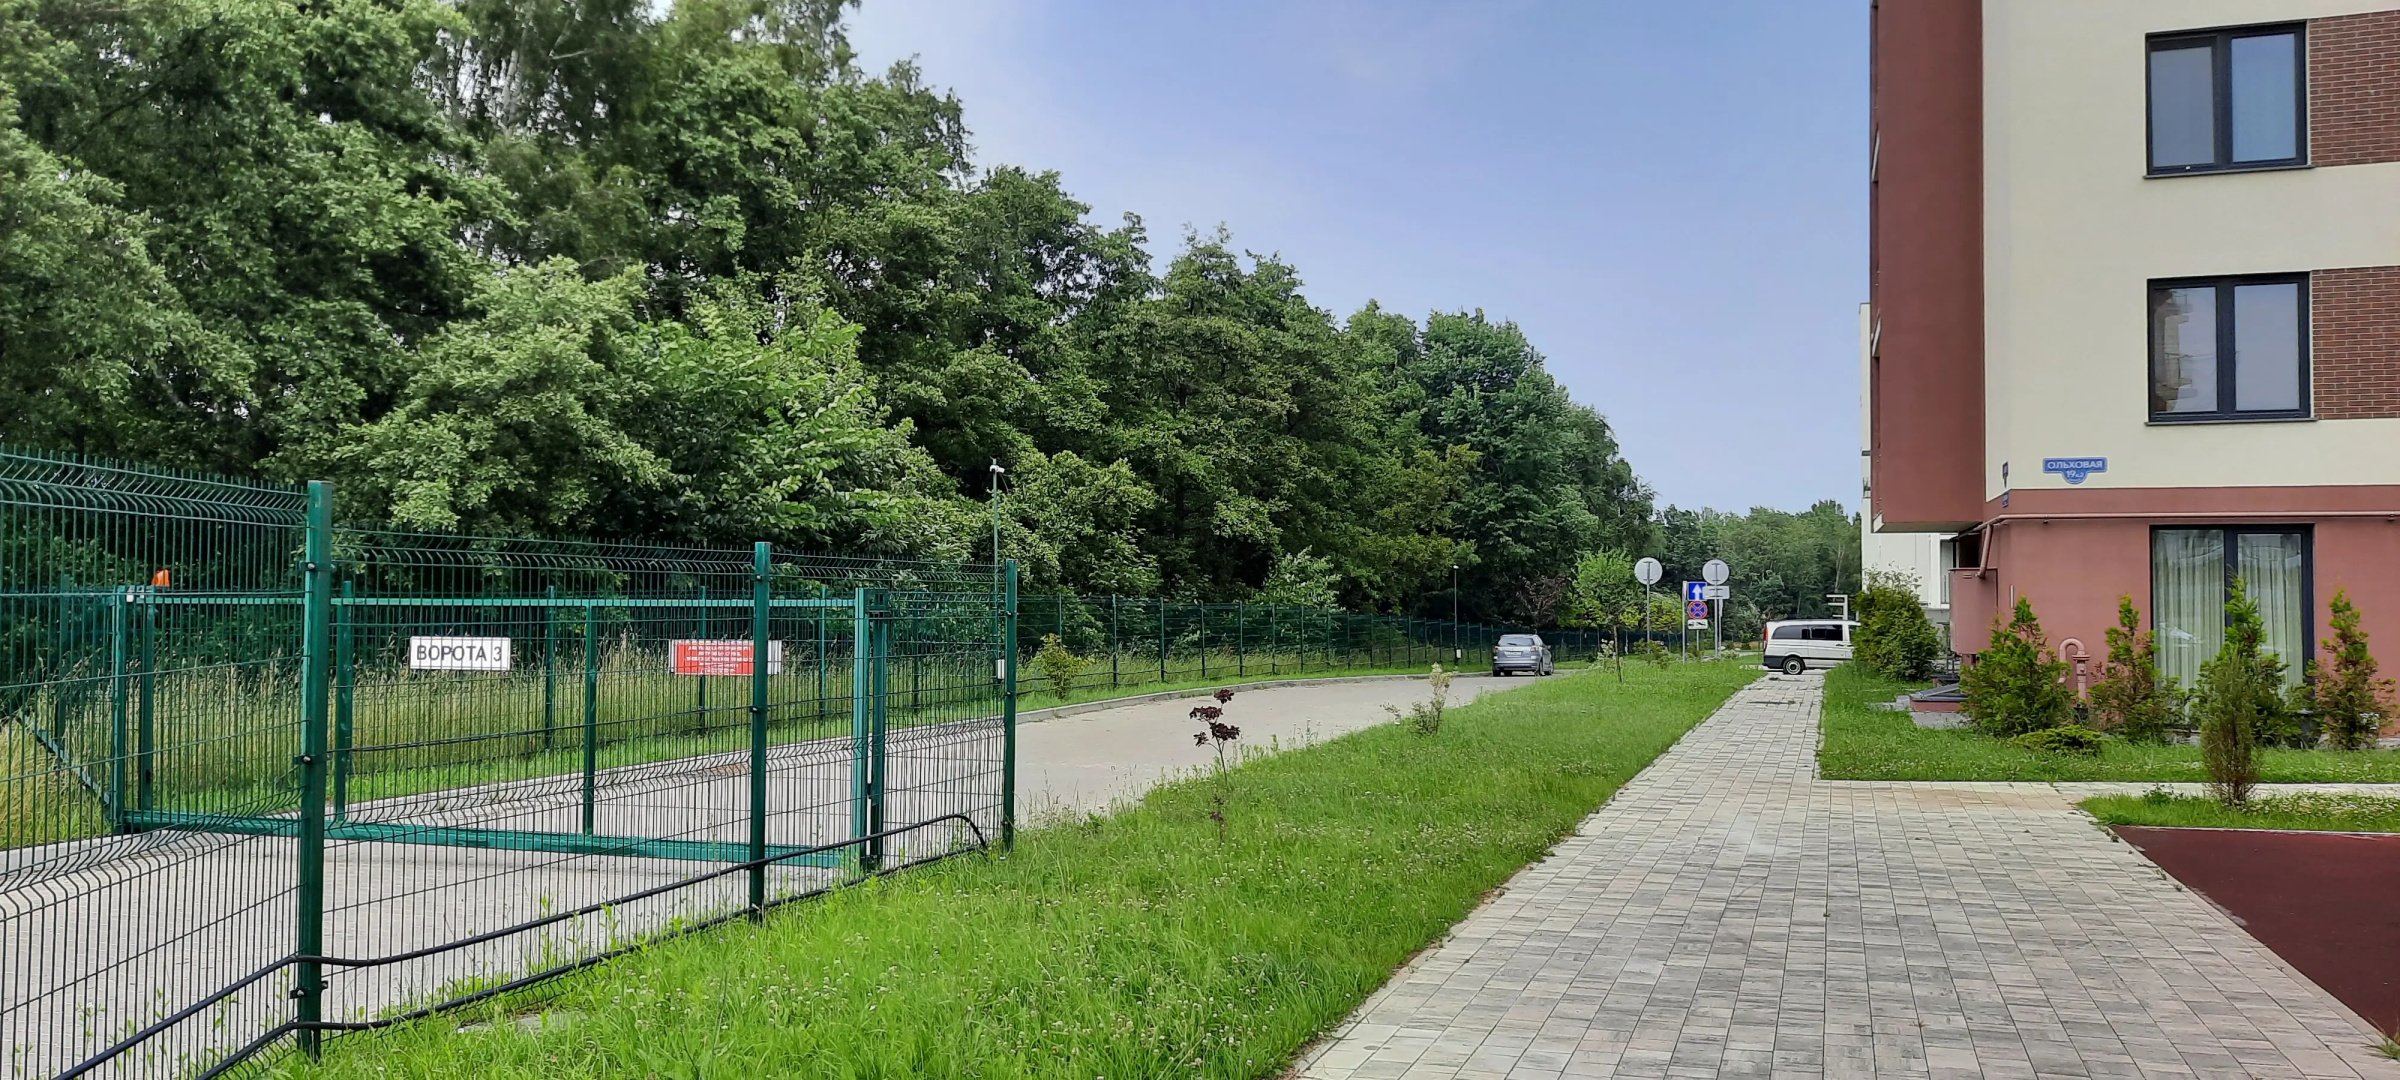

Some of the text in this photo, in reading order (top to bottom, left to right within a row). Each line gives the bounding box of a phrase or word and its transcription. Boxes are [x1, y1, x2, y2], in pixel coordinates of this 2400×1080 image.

[2047, 461, 2103, 469] ОЛЬХОВАЯ
[416, 645, 502, 662] ВОРОТА 3
